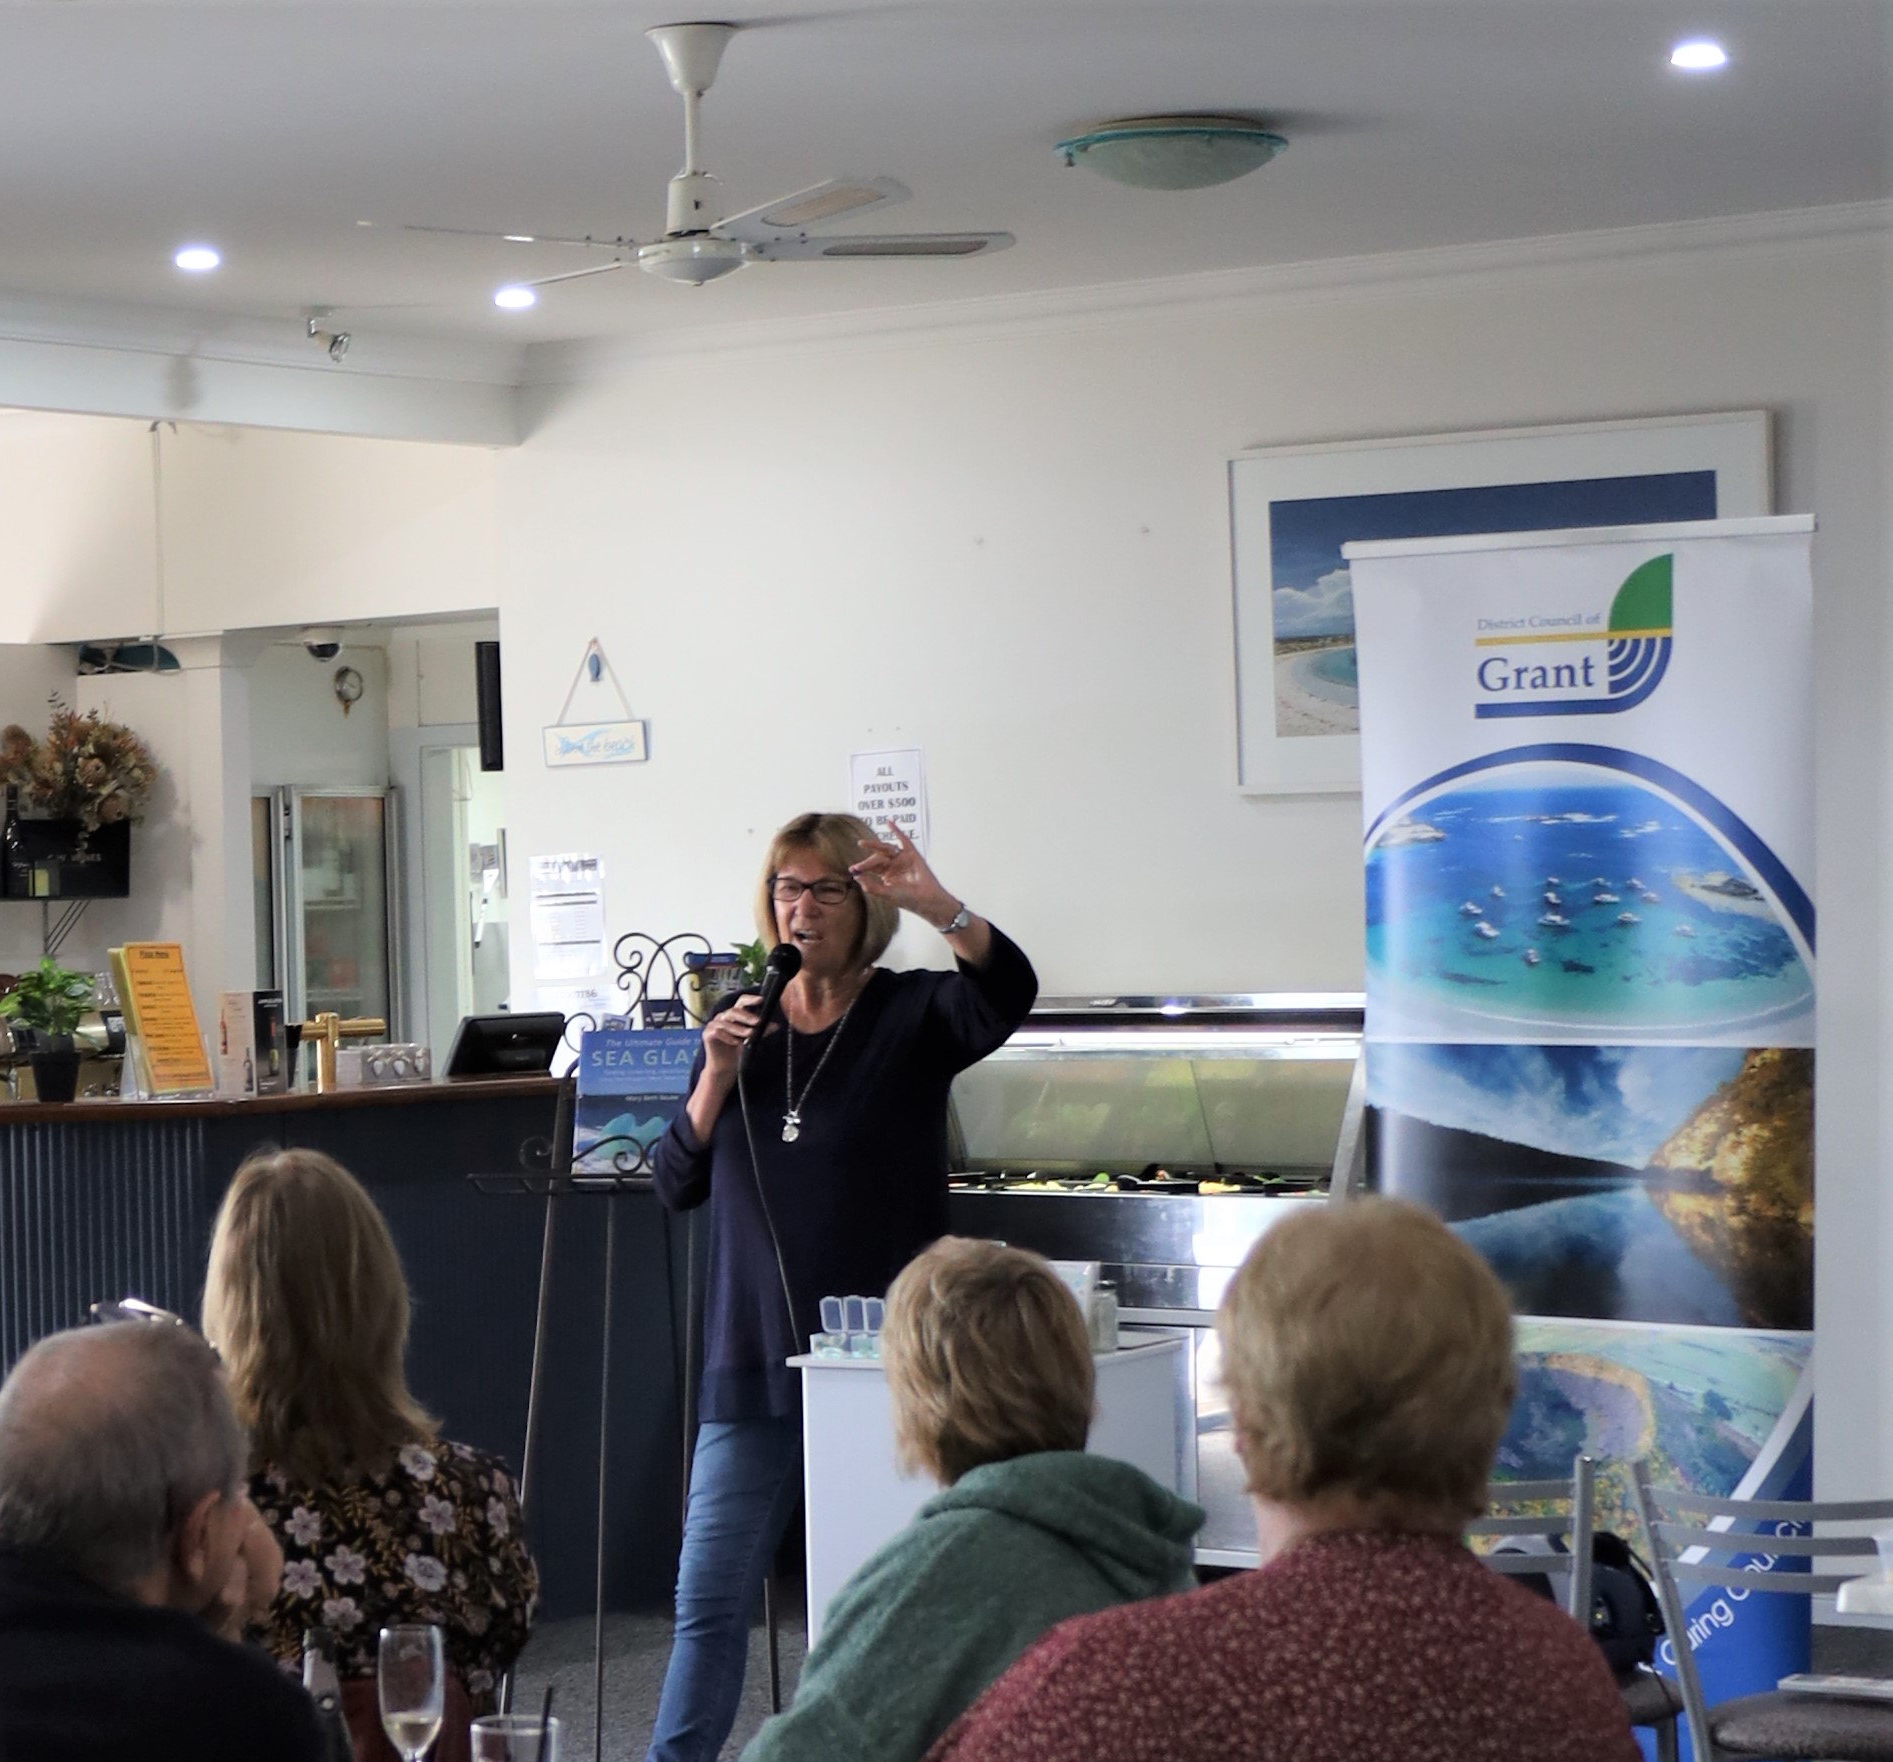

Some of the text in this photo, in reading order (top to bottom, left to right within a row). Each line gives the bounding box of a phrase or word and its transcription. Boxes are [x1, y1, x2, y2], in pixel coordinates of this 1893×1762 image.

[1478, 612, 1601, 631] District Council of
[1477, 655, 1595, 692] Grant
[875, 766, 895, 777] ALL
[863, 781, 909, 794] PAYOUTS
[857, 797, 917, 811] OVER $500
[591, 1050, 635, 1067] SEA
